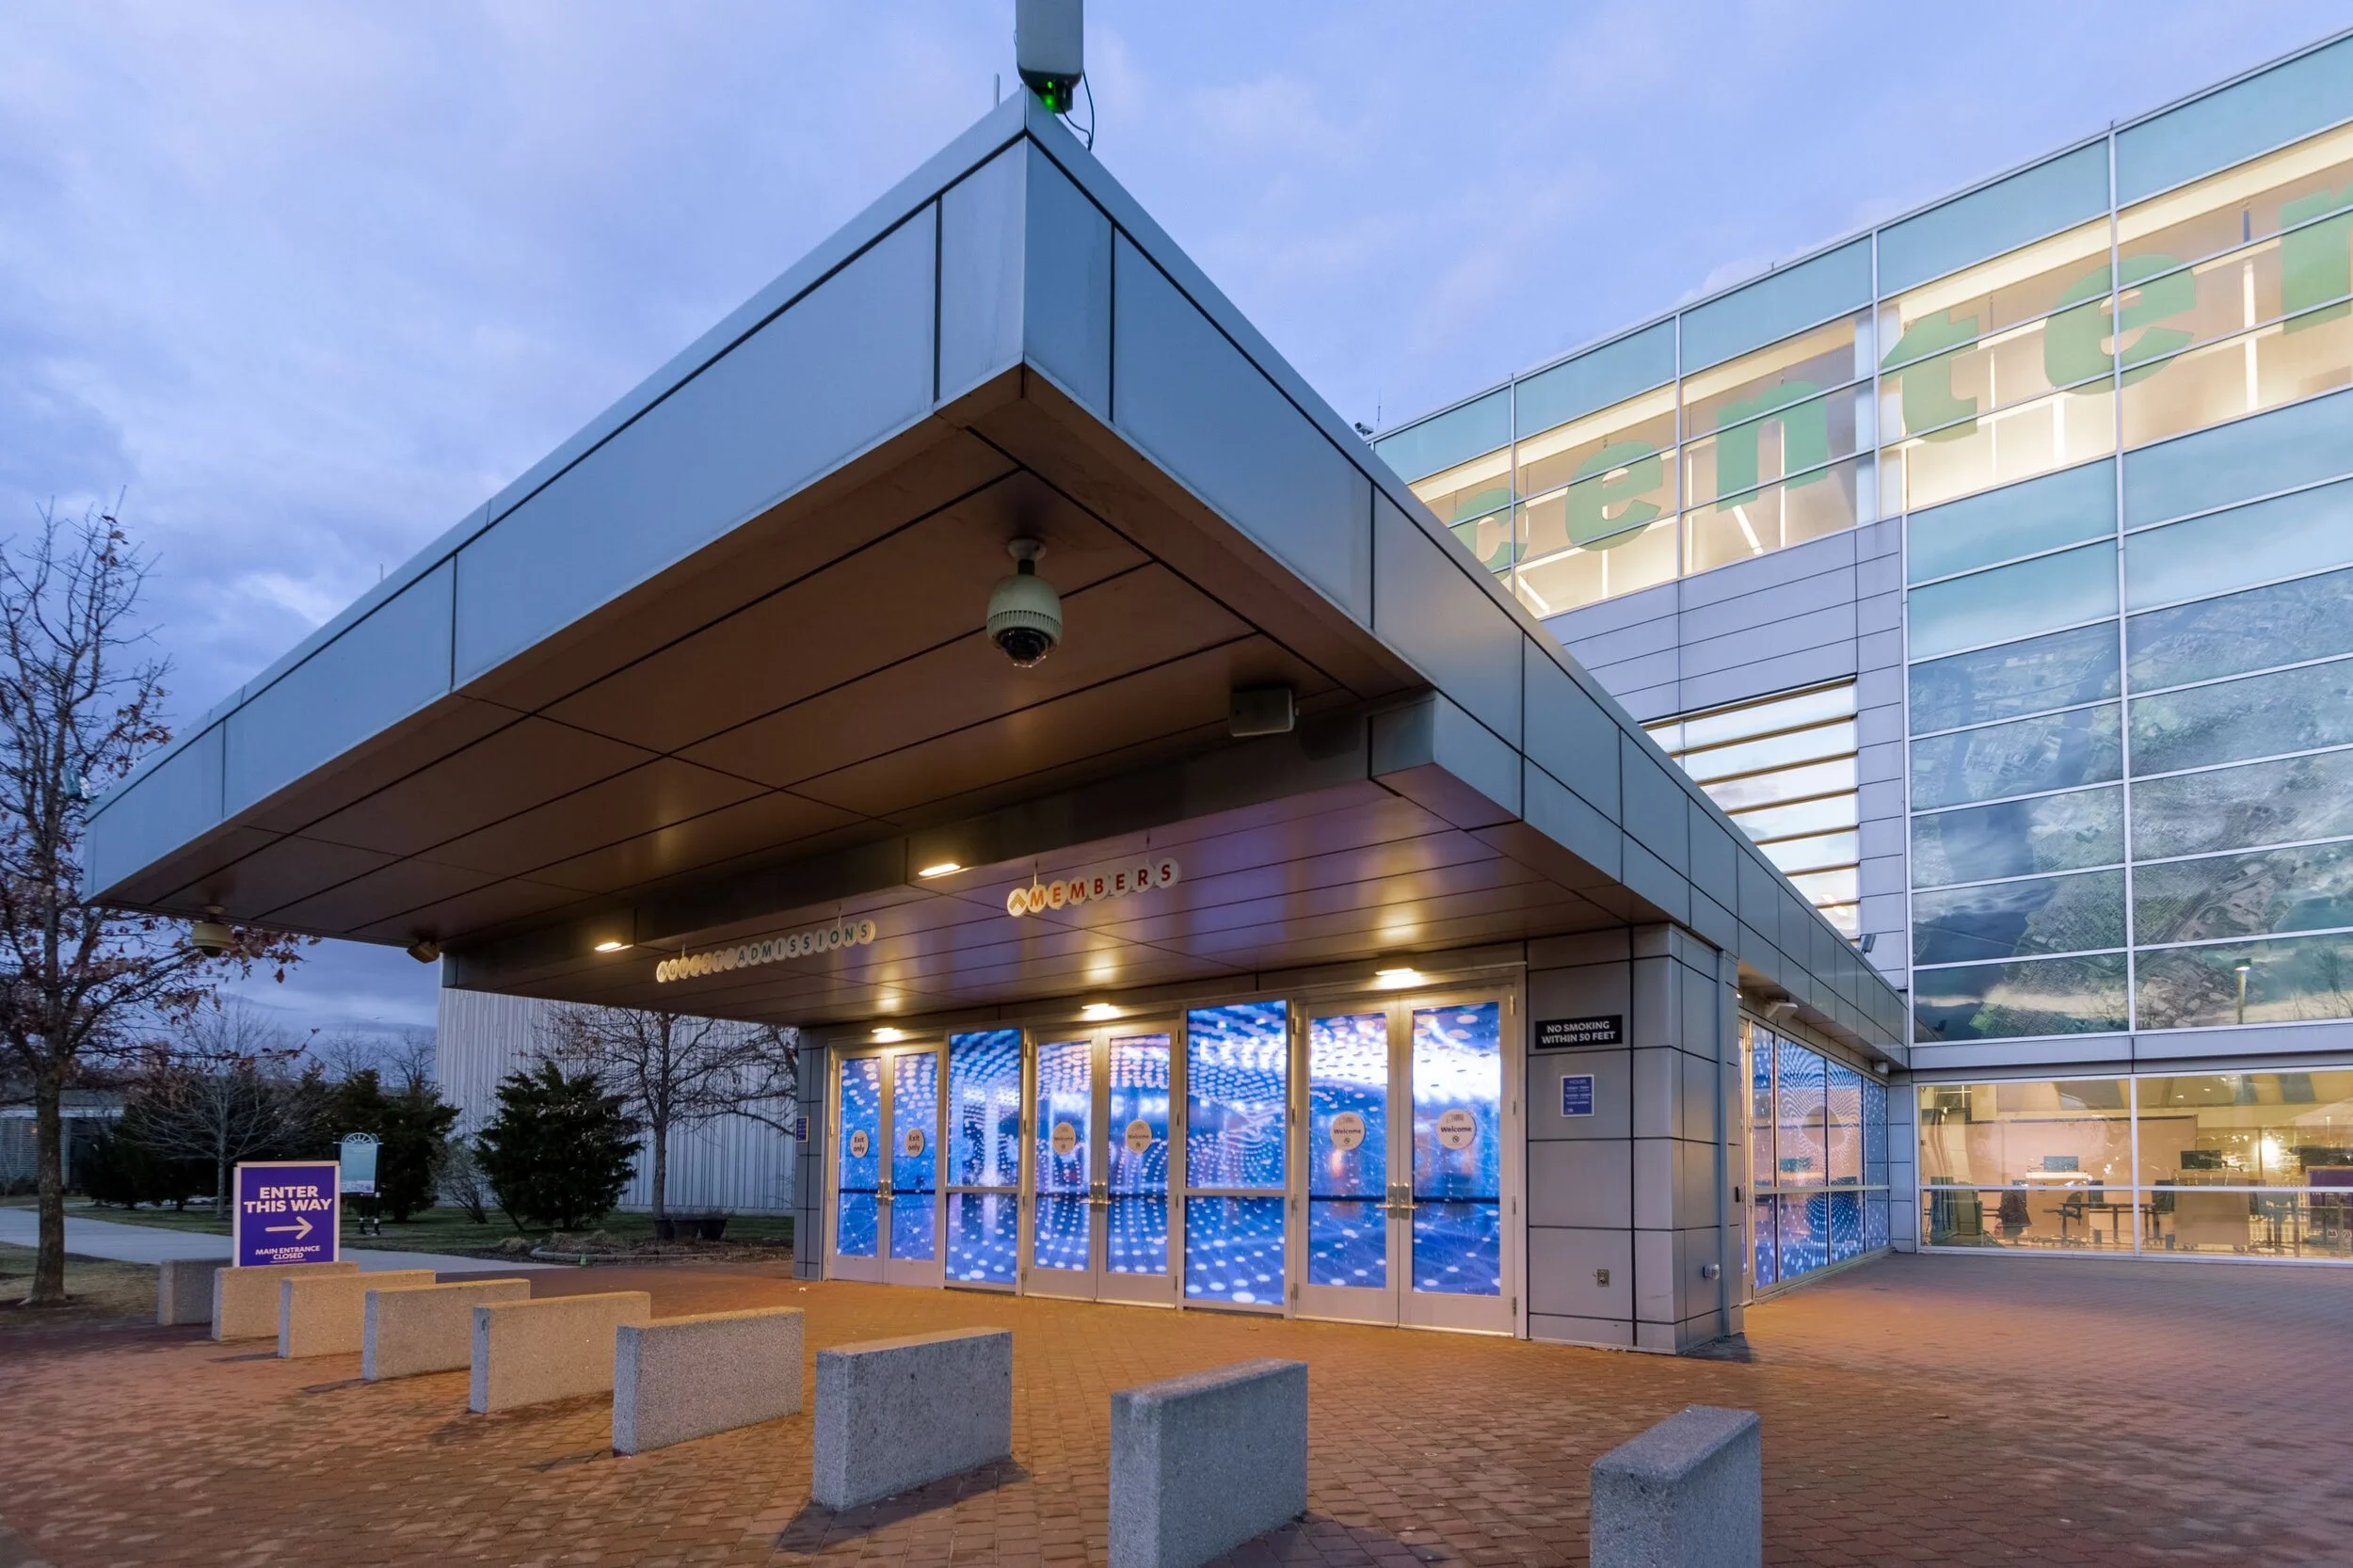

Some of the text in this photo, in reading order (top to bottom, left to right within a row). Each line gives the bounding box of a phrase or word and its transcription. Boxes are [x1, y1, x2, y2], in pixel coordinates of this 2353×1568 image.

[1030, 864, 1171, 907] MEMBERS
[737, 924, 868, 963] ADMISSIONS
[1546, 1020, 1610, 1033] NO SMOKING
[1542, 1031, 1616, 1045] WITHIN 50 FEET
[907, 1144, 920, 1152] only
[259, 1185, 319, 1199] ENTER
[243, 1198, 332, 1213] THIS WAY
[255, 1245, 321, 1256] MAIN ENTRANCE
[273, 1252, 304, 1260] CLOSED
